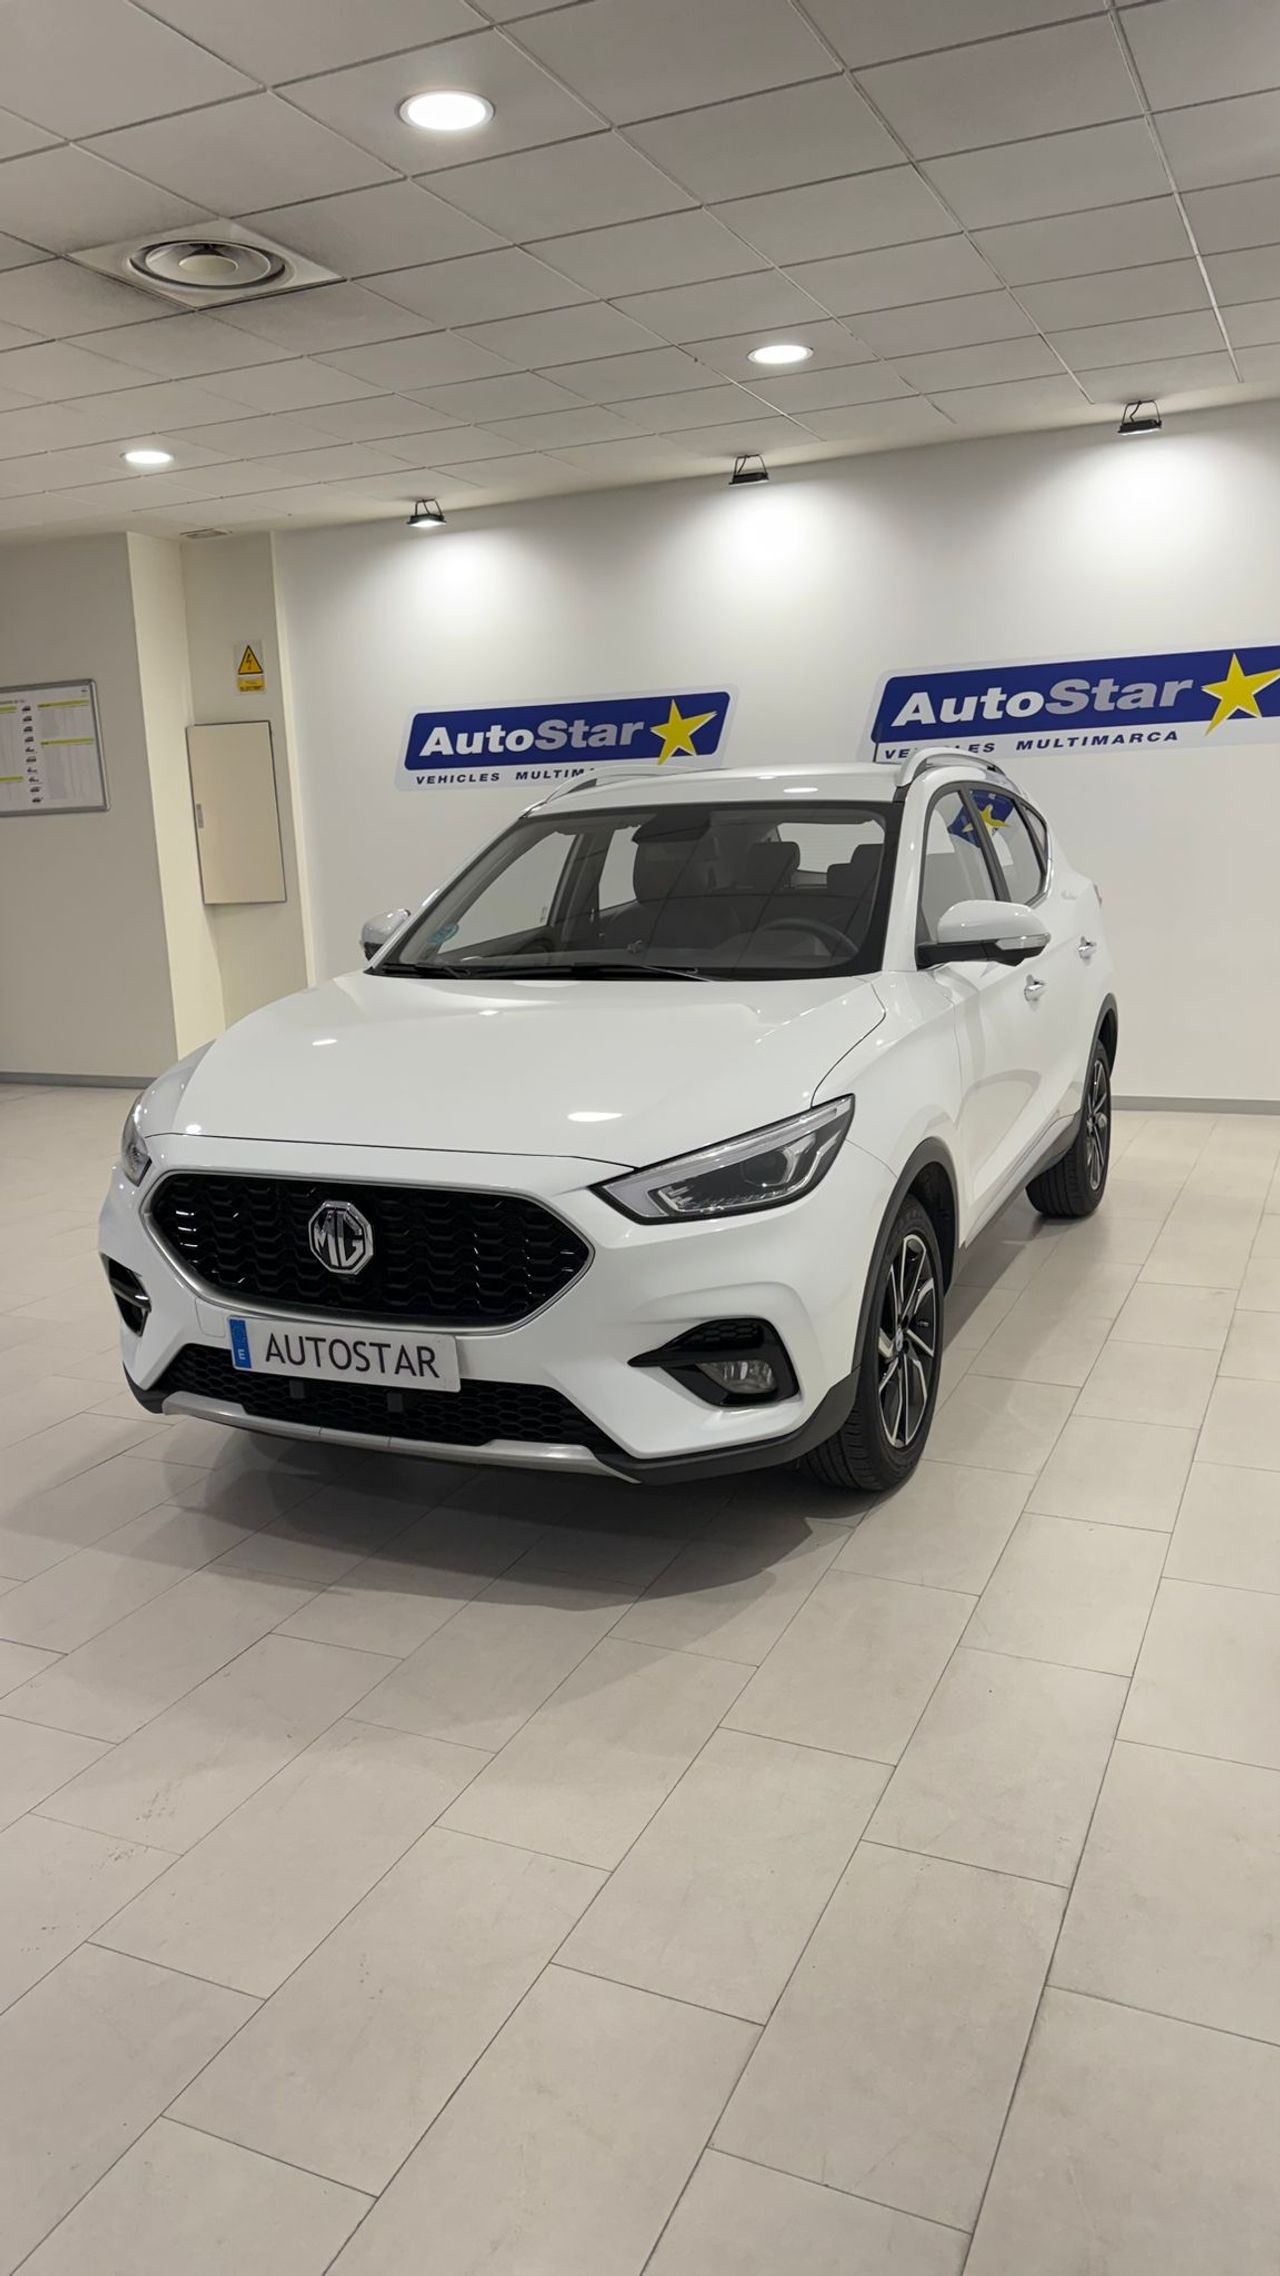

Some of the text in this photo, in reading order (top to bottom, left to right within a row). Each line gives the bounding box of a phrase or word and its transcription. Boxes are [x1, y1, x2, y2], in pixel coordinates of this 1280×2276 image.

[890, 678, 1194, 727] AutoStar
[419, 718, 645, 757] AutoStar
[884, 730, 1179, 759] VEES MULTIMARCA
[416, 767, 595, 785] VEHICLES MULTIM
[312, 1207, 365, 1269] MG
[238, 1332, 440, 1379] E AUTOSTAR
